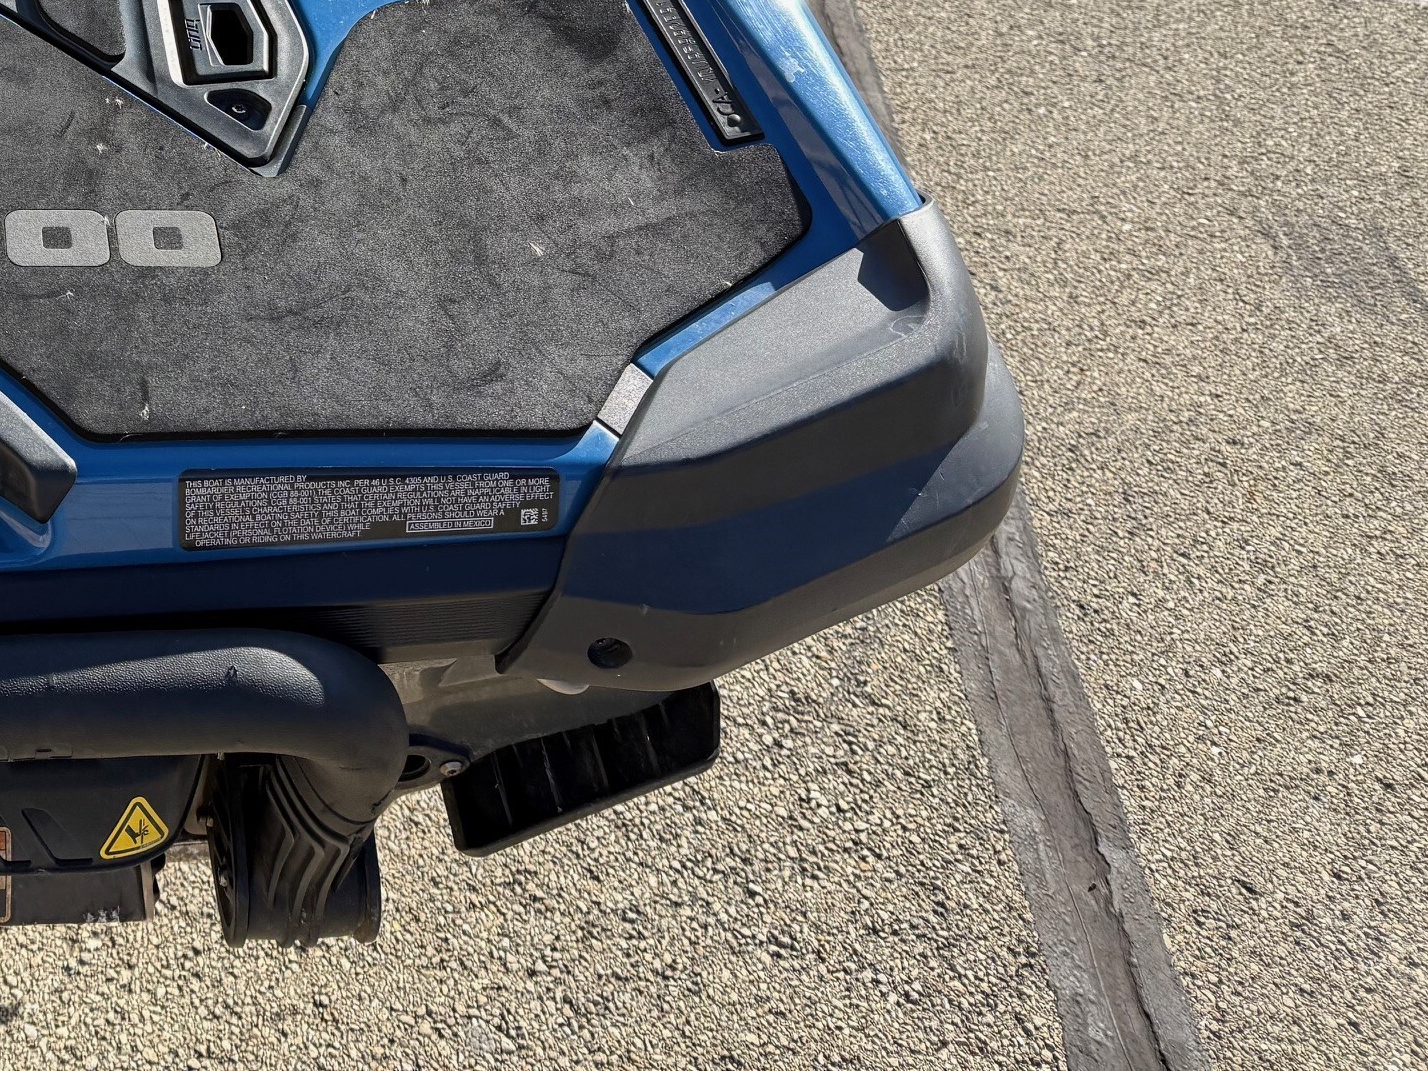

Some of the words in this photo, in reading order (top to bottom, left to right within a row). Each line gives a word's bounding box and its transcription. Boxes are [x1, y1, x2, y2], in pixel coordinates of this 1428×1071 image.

[186, 480, 202, 488] THIS
[204, 479, 223, 487] BOAT
[233, 475, 295, 485] MANUFACTURED
[186, 486, 234, 496] BOMBARDIER
[236, 483, 292, 493] RECREATIONAL
[294, 481, 336, 490] PRODUCTS
[354, 479, 369, 487] PER
[456, 473, 482, 482] COAST
[483, 472, 509, 481] GUARD
[186, 495, 210, 503] GRANT
[225, 492, 268, 501] EXEMPTION
[334, 487, 359, 495] COAST
[361, 486, 387, 494] GUARD
[389, 484, 425, 492] EXEMPTS
[426, 483, 443, 491] THIS
[444, 481, 473, 490] VESSEL
[475, 480, 496, 488] FROM
[498, 479, 513, 487] ONE
[528, 477, 550, 485] MORE
[186, 503, 213, 511] SAFETY
[314, 495, 342, 504] STATES
[364, 492, 395, 501] CERTAIN
[397, 489, 449, 499] REGULATIONS
[451, 489, 465, 497] ARE
[467, 486, 519, 495] INAPPLICABLE
[529, 485, 550, 493] LIGHT
[198, 509, 213, 517] THIS
[252, 504, 321, 514] CHARACTERISTICS
[377, 499, 420, 508] EXEMPTION
[457, 495, 477, 503] HAVE
[478, 495, 489, 503] AN
[490, 493, 524, 502] ADVERSE
[526, 492, 554, 500] EFFECT
[186, 518, 196, 526] ON
[198, 515, 253, 525] RECREATIONAL
[256, 513, 288, 521] BOATING
[361, 507, 399, 515] COMPLIES
[465, 502, 491, 510] GUARD
[492, 501, 521, 509] SAFETY
[186, 524, 230, 533] STANDARDS
[407, 512, 443, 520] PERSONS
[445, 510, 474, 518] SHOULD
[476, 509, 498, 517] WEAR
[410, 521, 453, 529] ASSEMBLED
[462, 519, 491, 527] MEXICO
[195, 537, 237, 547] OPERATING
[252, 535, 278, 543] RIDING
[274, 526, 314, 534] FLOTATION
